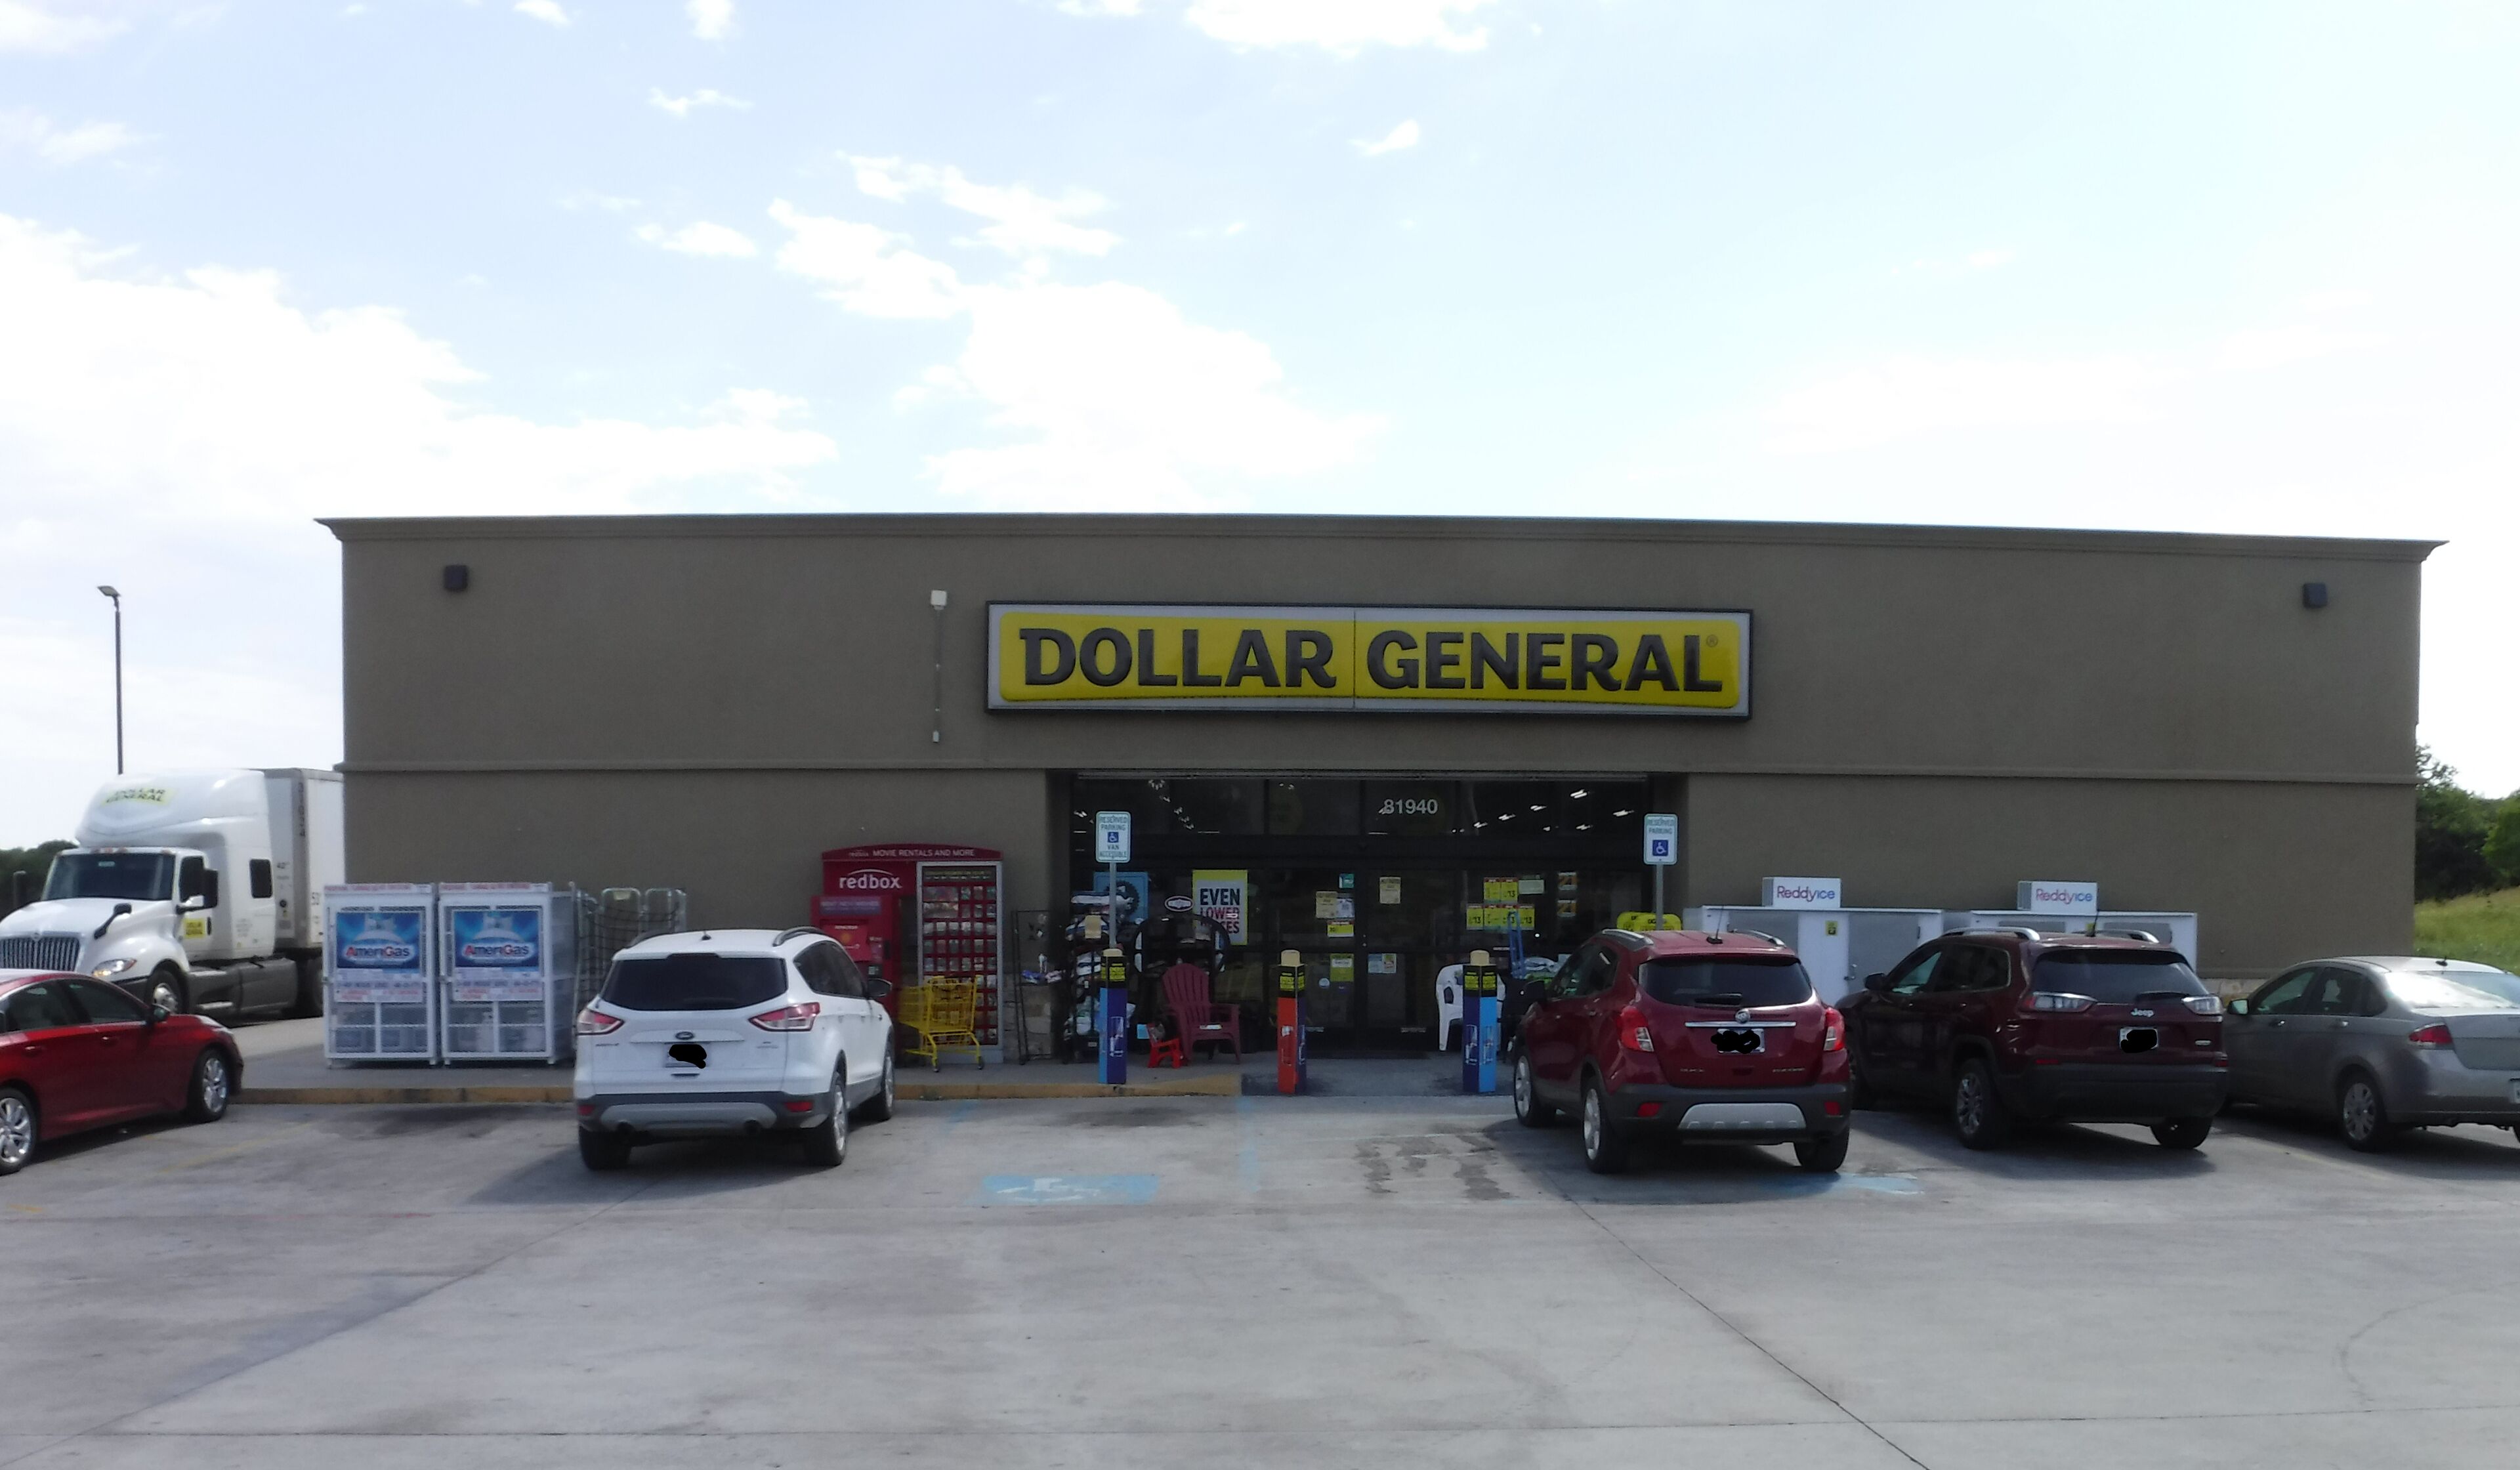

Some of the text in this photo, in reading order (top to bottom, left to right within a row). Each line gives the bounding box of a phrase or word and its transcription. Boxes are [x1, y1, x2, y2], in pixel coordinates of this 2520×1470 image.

[1020, 628, 1723, 692] DOLLAR GENERAL
[1383, 799, 1438, 814] 81940
[839, 874, 902, 889] redbox
[1200, 888, 1240, 906] EVEN
[2130, 1007, 2154, 1018] Jeep
